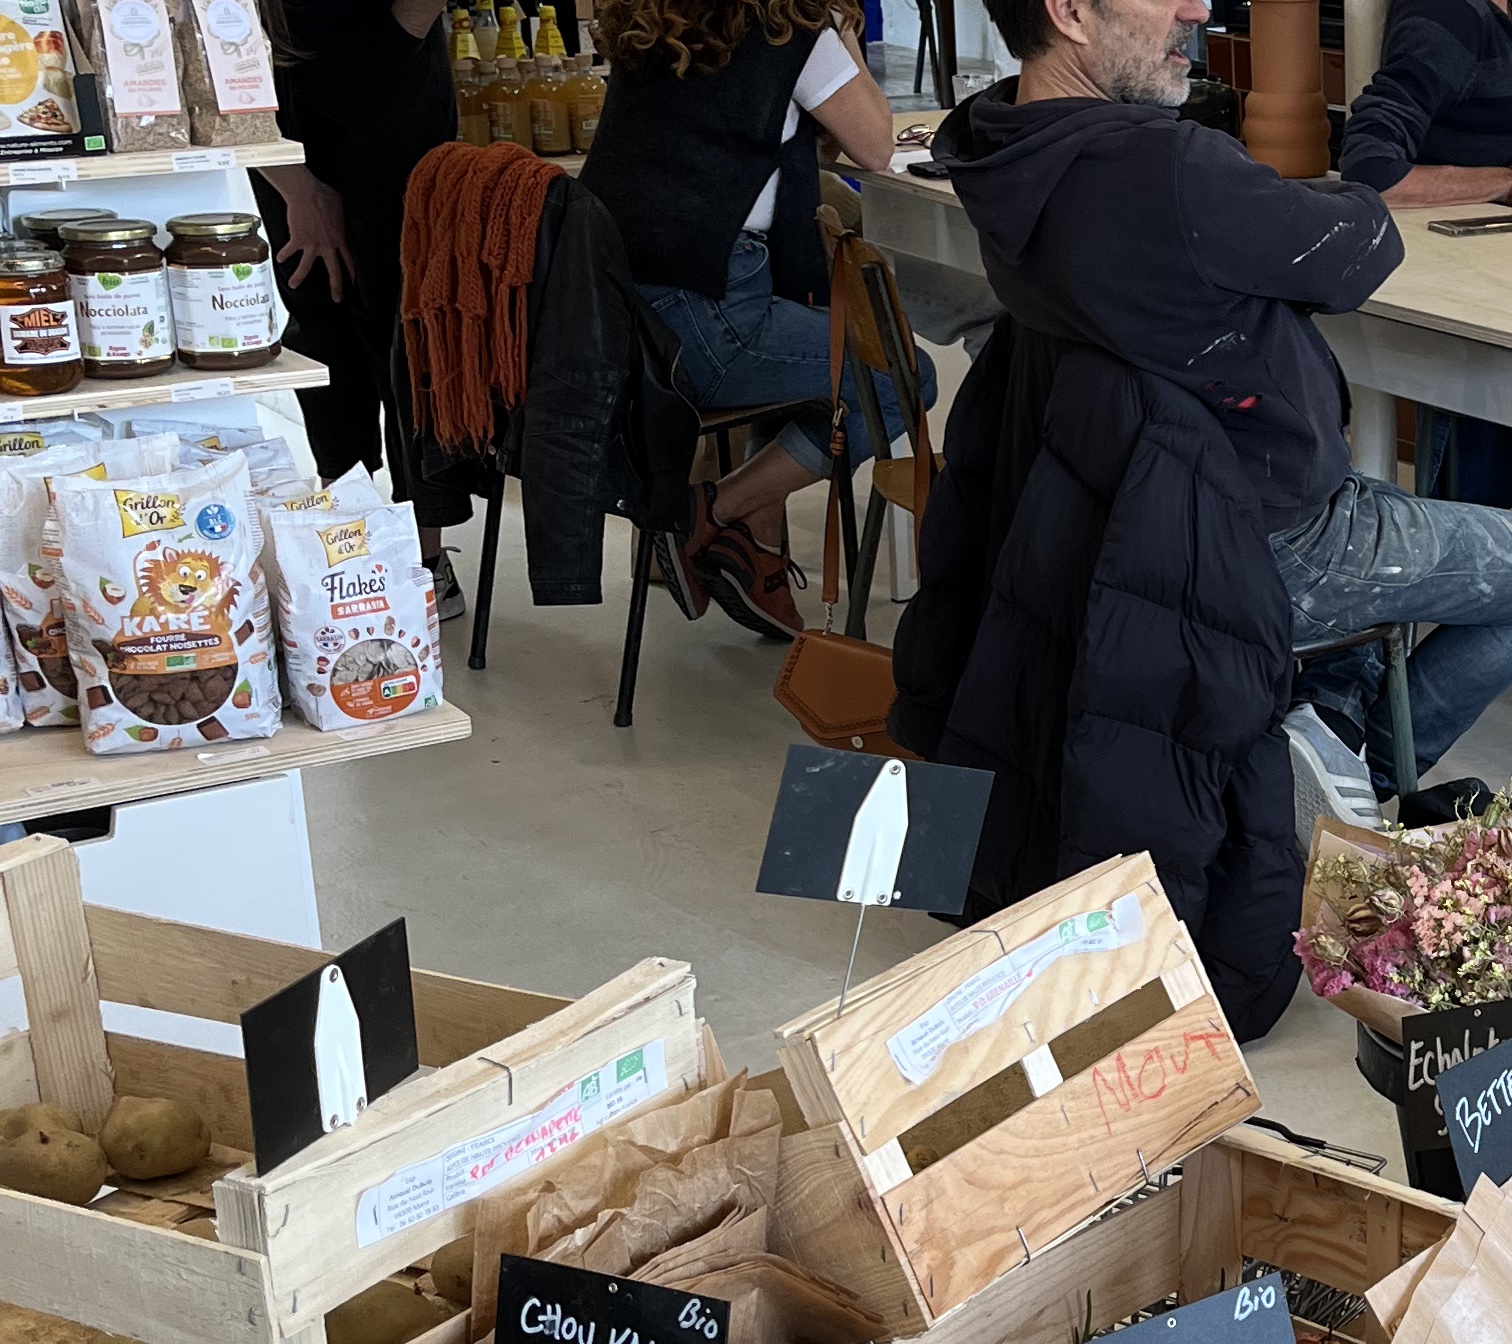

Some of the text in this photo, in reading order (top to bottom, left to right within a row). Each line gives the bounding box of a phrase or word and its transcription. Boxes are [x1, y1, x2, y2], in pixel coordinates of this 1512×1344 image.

[123, 78, 167, 88] AMANDES
[224, 76, 263, 86] AMANDES
[234, 266, 251, 278] bio
[99, 275, 120, 287] bio
[79, 301, 149, 319] Nocciolata
[23, 311, 56, 328] MIEL
[122, 495, 176, 512] Grillon
[326, 527, 362, 546] Grillon
[338, 541, 356, 555] d'Or
[321, 570, 386, 603] Flakes
[336, 602, 384, 616] SARRASIN
[169, 636, 220, 651] NOISETTES
[582, 1080, 599, 1101] AB
